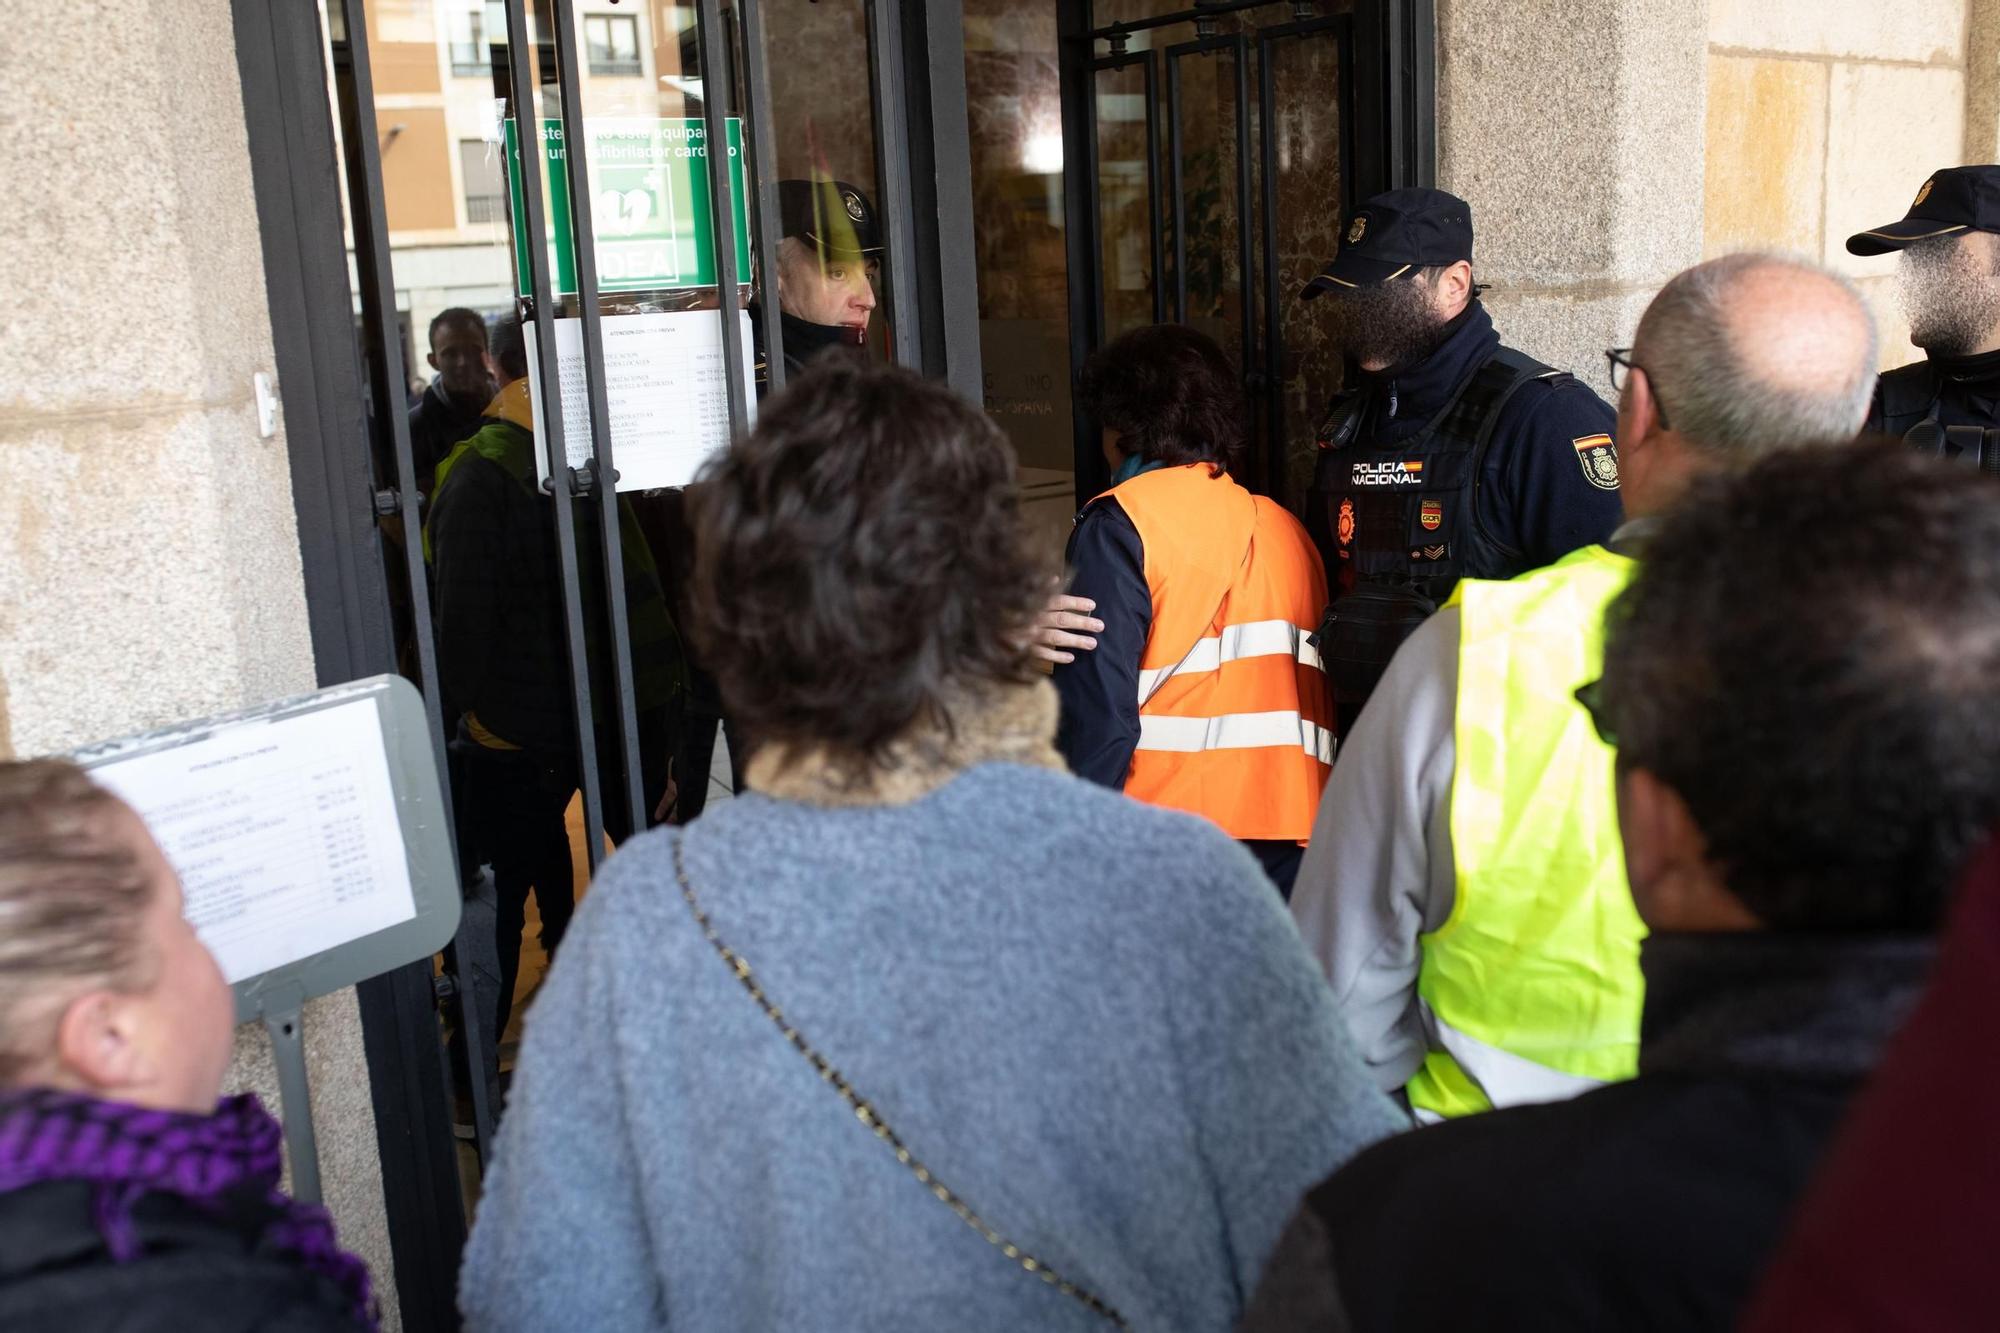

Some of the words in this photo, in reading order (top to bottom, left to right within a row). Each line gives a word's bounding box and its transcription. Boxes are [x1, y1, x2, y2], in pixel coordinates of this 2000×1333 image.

[538, 127, 563, 141] ste
[654, 126, 706, 142] equipa
[602, 250, 672, 279] DEA
[1352, 462, 1407, 474] POLICIA
[1351, 473, 1422, 486] NACIONAL
